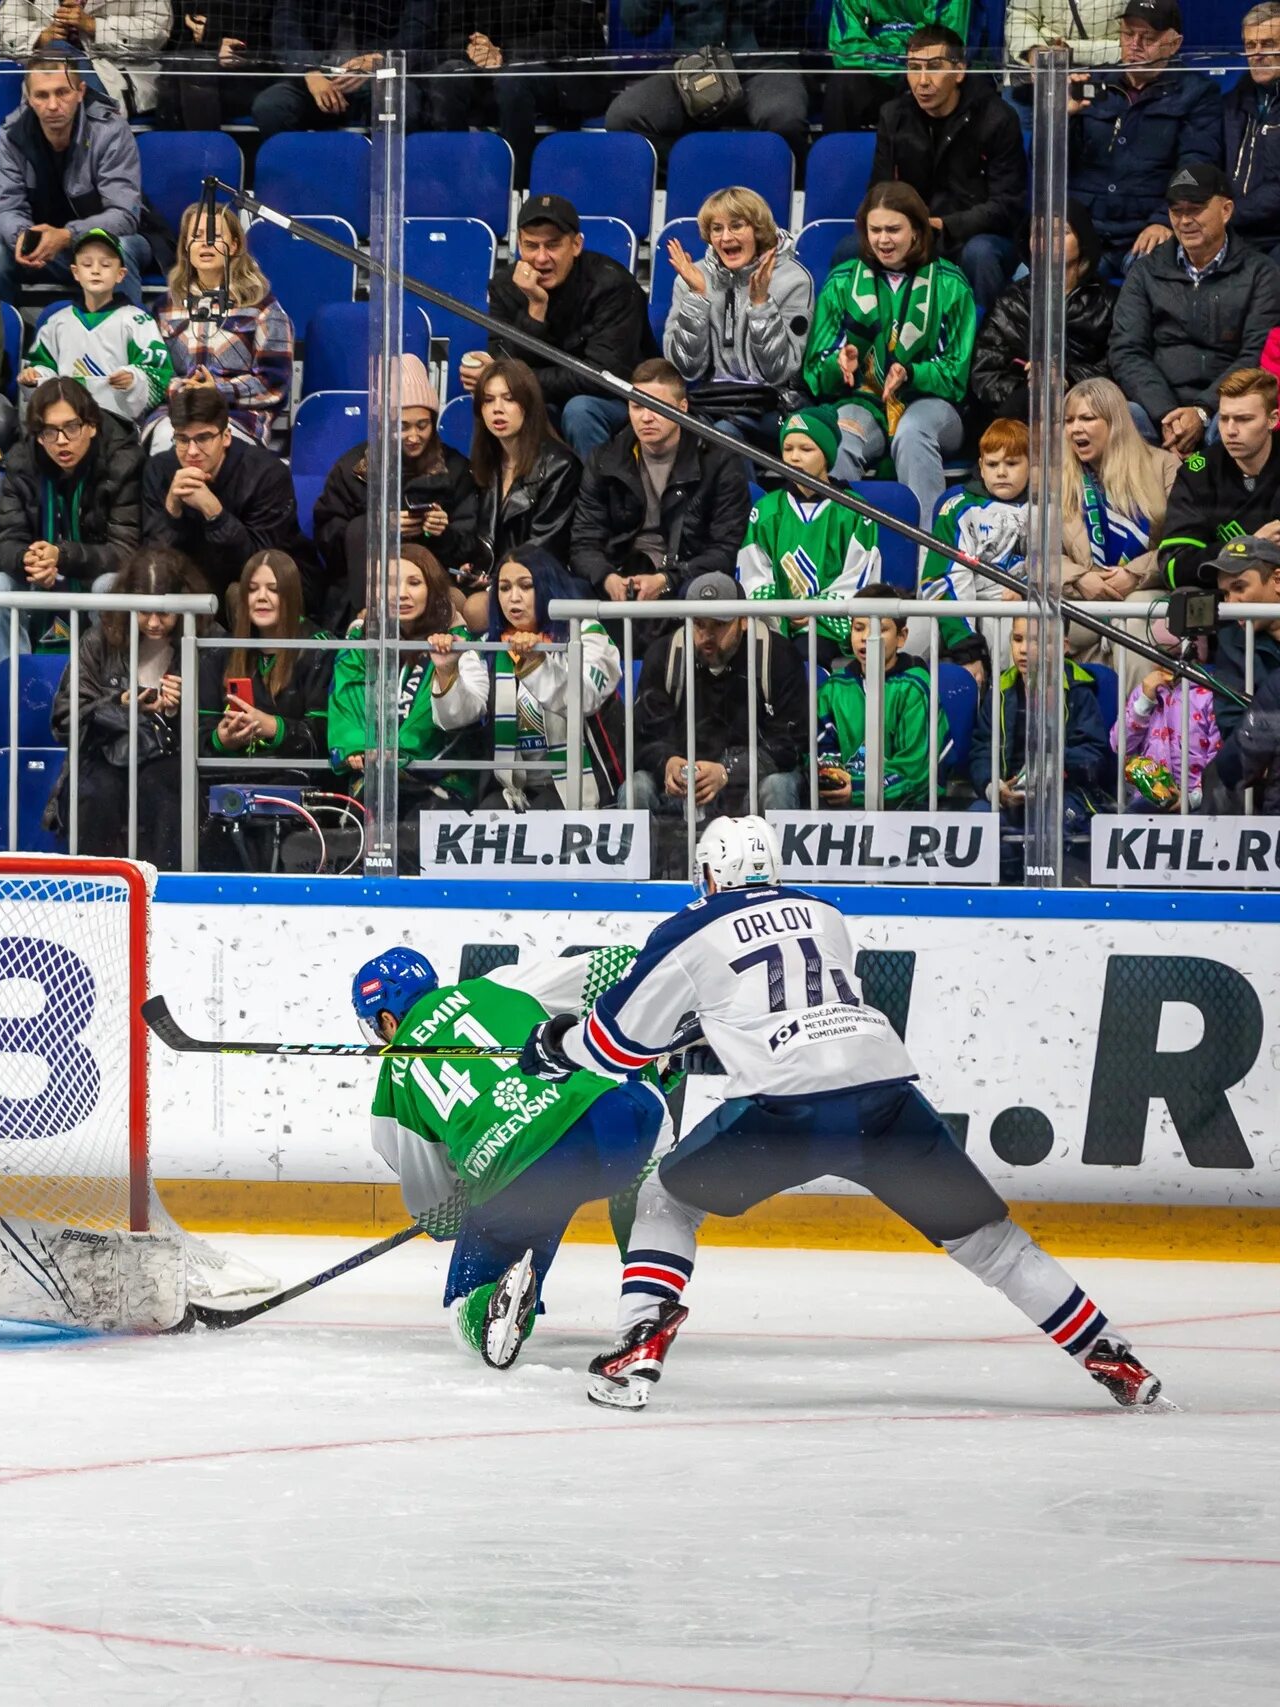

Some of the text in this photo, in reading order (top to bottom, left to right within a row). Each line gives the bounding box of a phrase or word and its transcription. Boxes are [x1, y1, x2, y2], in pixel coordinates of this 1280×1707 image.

[436, 823, 634, 865] KHL.RU
[748, 837, 765, 852] 74
[781, 824, 983, 868] KHL.RU
[1106, 828, 1280, 872] KHL.R
[365, 857, 393, 867] RAITA
[1026, 865, 1055, 876] RAITA
[733, 906, 814, 944] ORLOV
[276, 1042, 368, 1055] CCM
[390, 990, 471, 1090] KUEMIN
[807, 1024, 859, 1041] КОМПАНИЯ
[407, 1011, 518, 1123] 41
[468, 1083, 562, 1179] VIDINEEVSKY
[604, 1347, 650, 1376] CCM
[1089, 1362, 1120, 1372] CCM
